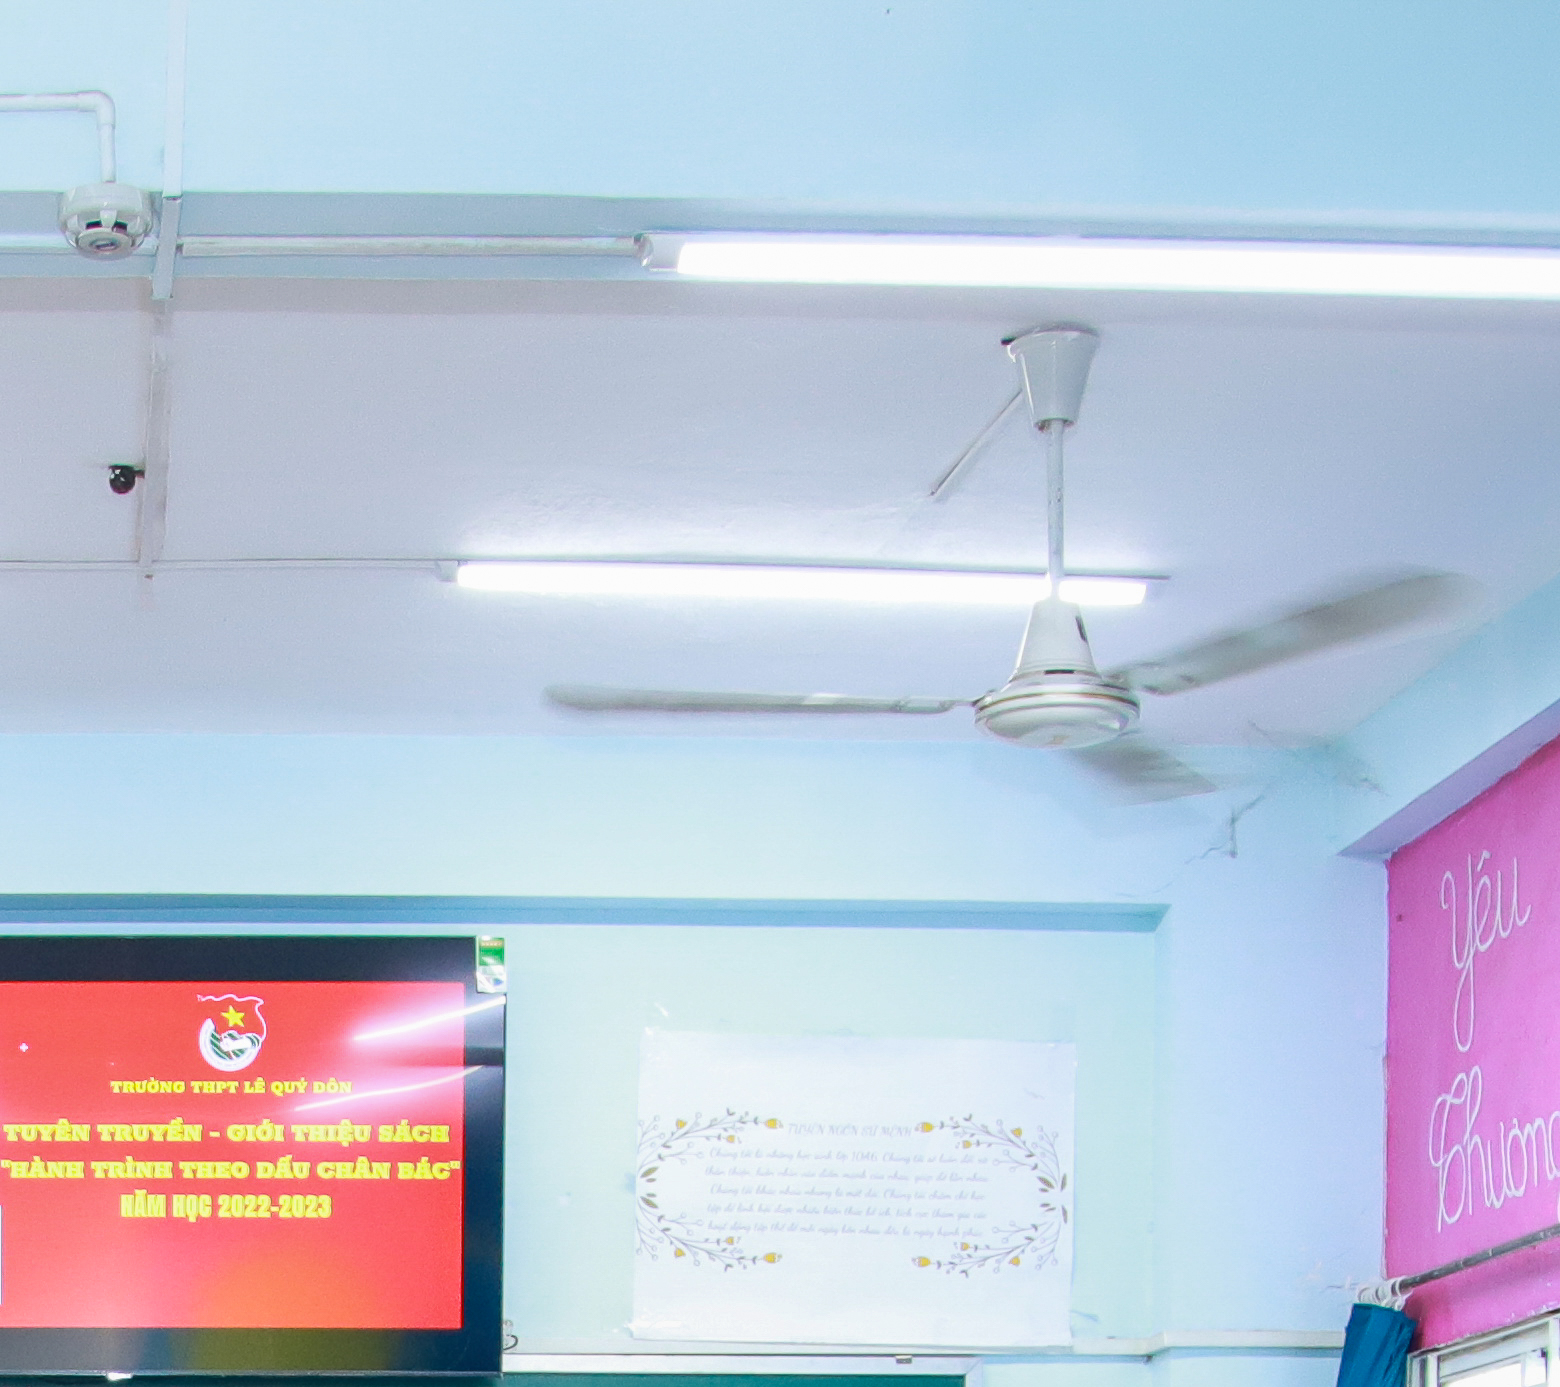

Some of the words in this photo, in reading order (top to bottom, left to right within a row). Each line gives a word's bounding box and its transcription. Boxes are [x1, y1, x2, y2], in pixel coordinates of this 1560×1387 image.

[111, 1077, 186, 1094] TRƯỜNG
[191, 1080, 239, 1094] THPT
[243, 1077, 266, 1094] LÊ
[271, 1077, 308, 1097] QUÝ
[2, 1118, 92, 1142] TUYÊN
[226, 1119, 285, 1142] GIỚI
[290, 1119, 373, 1147] THIỆU
[378, 1119, 451, 1142] SÁCH
[90, 1156, 174, 1179] TRÌNH
[179, 1161, 250, 1180] THEO
[256, 1155, 312, 1180] DẤU
[317, 1156, 393, 1180] CHÂN
[120, 1189, 168, 1218] NĂM
[172, 1194, 213, 1223] HỌC
[218, 1194, 333, 1219] 2022-2023
